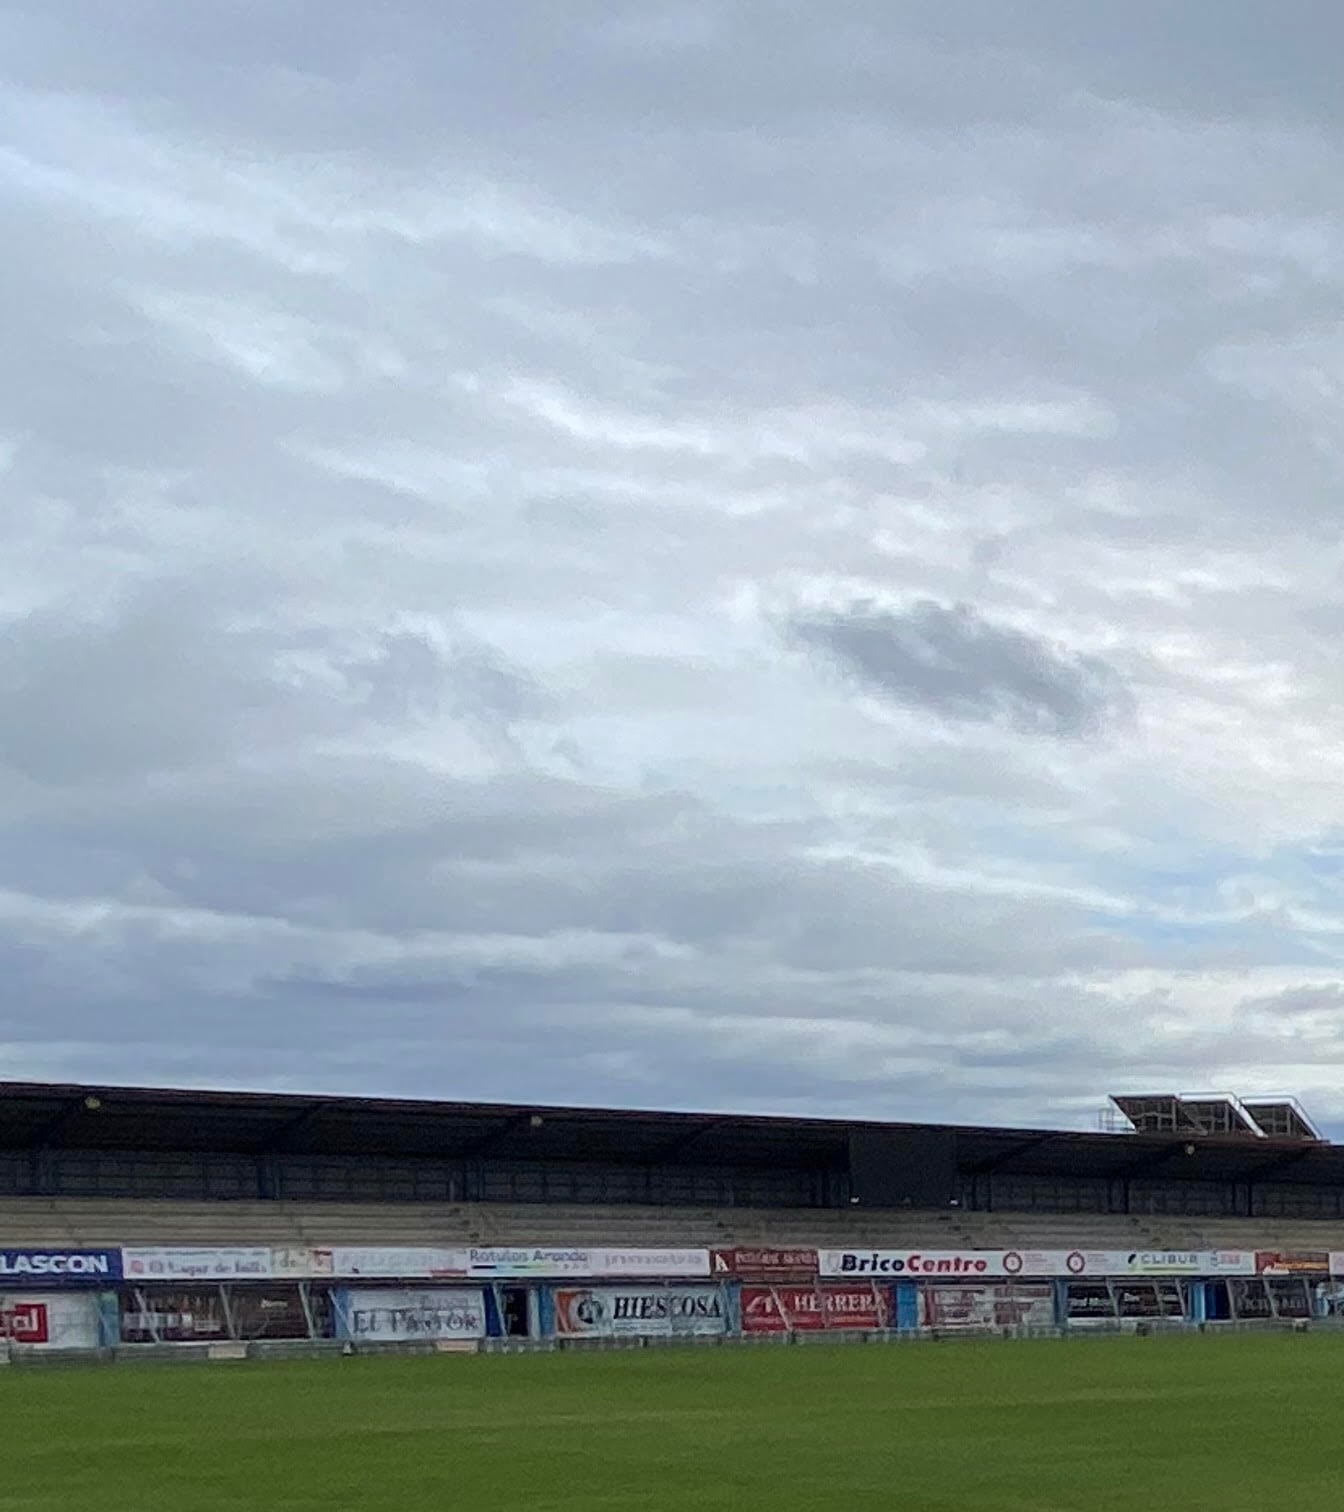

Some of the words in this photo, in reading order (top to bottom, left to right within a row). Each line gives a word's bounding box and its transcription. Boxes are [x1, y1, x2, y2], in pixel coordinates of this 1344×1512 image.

[533, 1250, 588, 1262] Aranda
[842, 1253, 987, 1272] BricoCentro
[1141, 1254, 1199, 1265] CLIBUR
[613, 1296, 721, 1319] HIESCOSA
[794, 1294, 887, 1312] HERRERA
